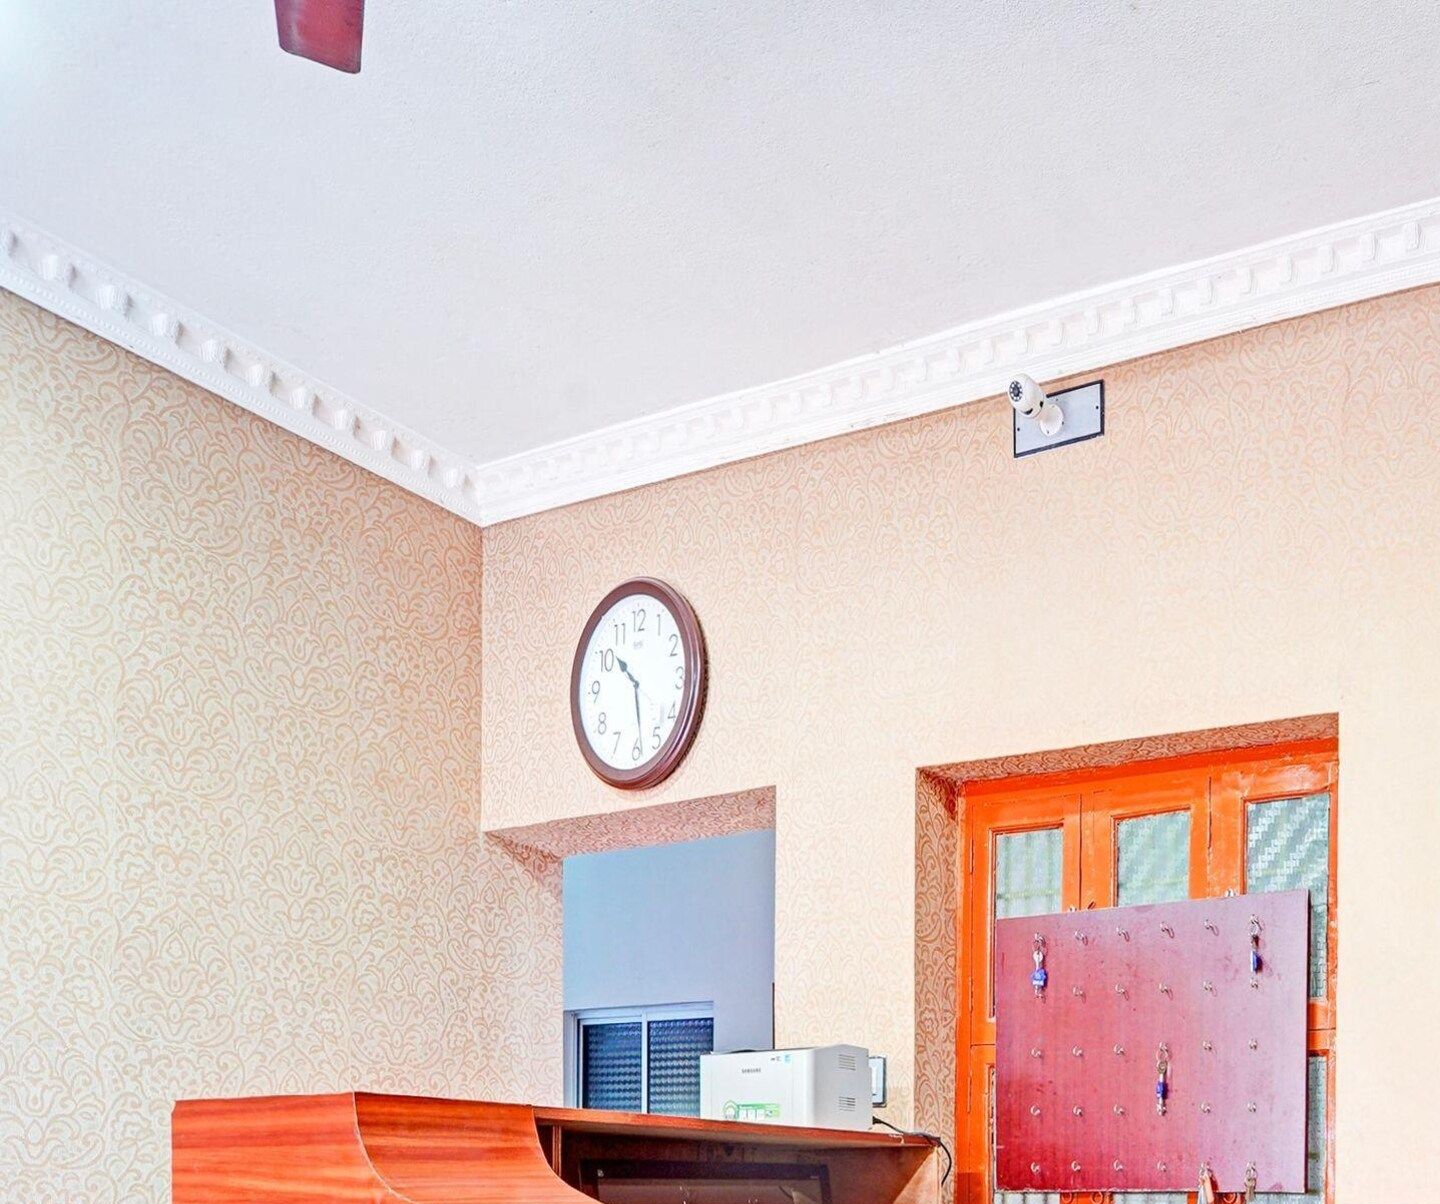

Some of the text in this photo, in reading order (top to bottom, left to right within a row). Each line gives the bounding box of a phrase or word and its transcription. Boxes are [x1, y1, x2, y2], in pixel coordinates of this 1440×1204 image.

[632, 609, 646, 632] 12
[656, 614, 661, 636] 1
[614, 623, 626, 646] 11
[669, 634, 678, 657] 2
[599, 648, 614, 672] 10
[675, 666, 684, 690] 3
[591, 680, 600, 704] 9
[667, 702, 676, 721] 4
[597, 712, 607, 735] 8
[612, 731, 621, 755] 7
[632, 737, 641, 761] 6
[652, 726, 661, 750] 5
